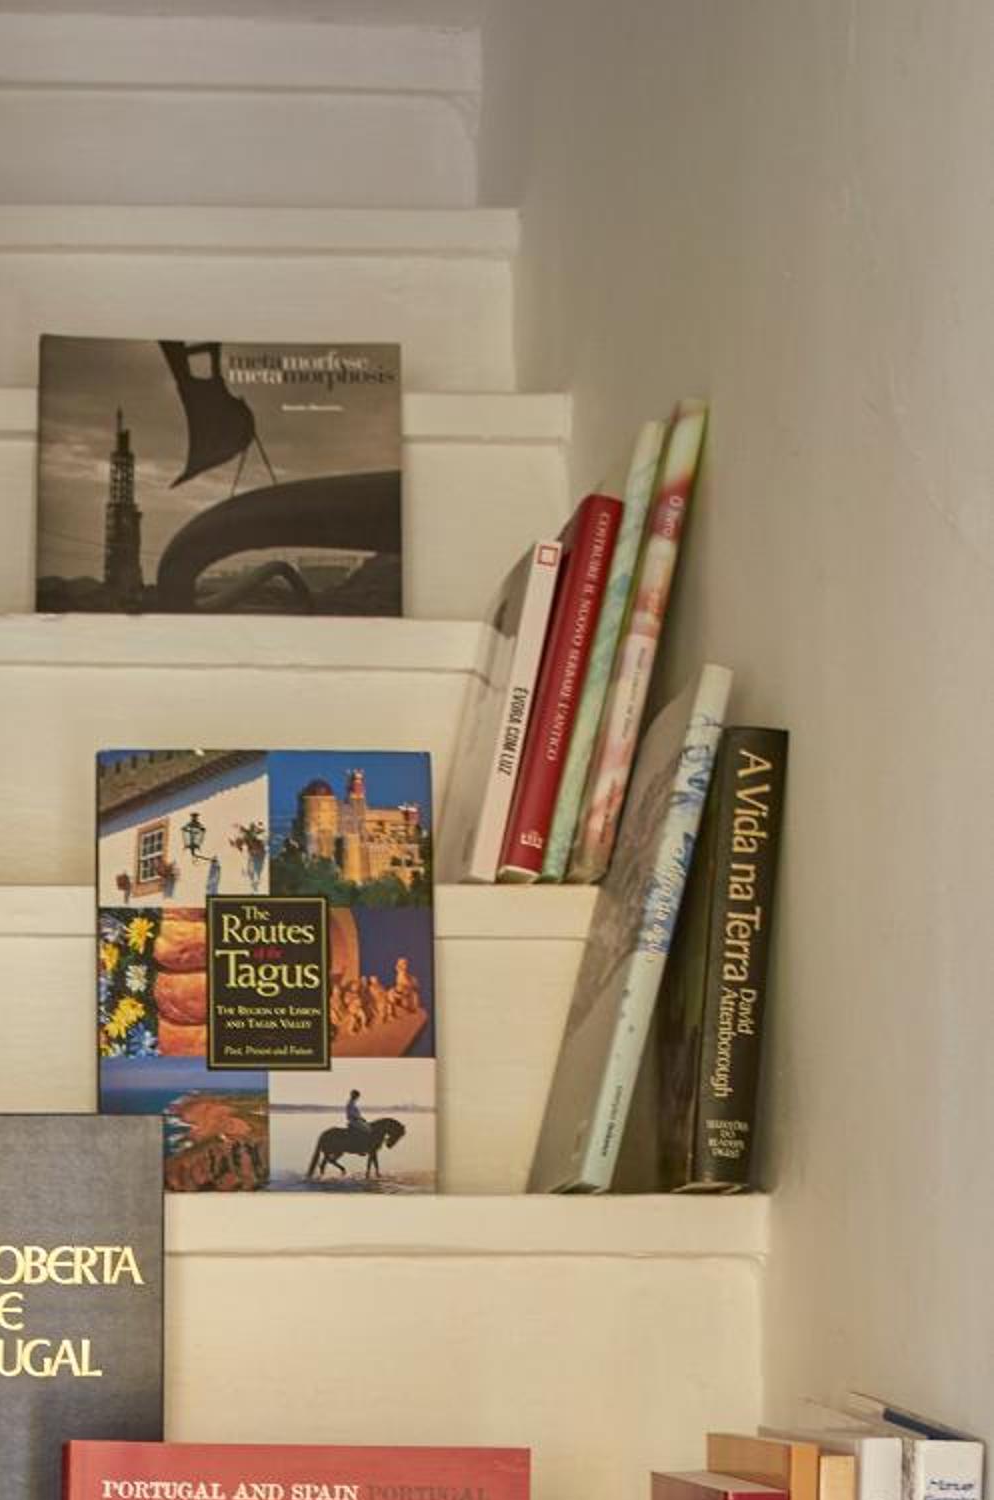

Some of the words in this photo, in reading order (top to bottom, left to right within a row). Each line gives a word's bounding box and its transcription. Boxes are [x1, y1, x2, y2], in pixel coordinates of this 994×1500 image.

[737, 748, 773, 781] A
[730, 780, 771, 855] Vida
[727, 862, 755, 900] na
[222, 913, 315, 944] Routes
[241, 906, 270, 921] The
[719, 902, 761, 982] Terra
[215, 949, 320, 997] Tagus
[735, 988, 758, 1034] David
[707, 986, 742, 1098] Attenborough
[102, 1480, 226, 1500] PORTUGAL
[233, 1482, 284, 1500] AND
